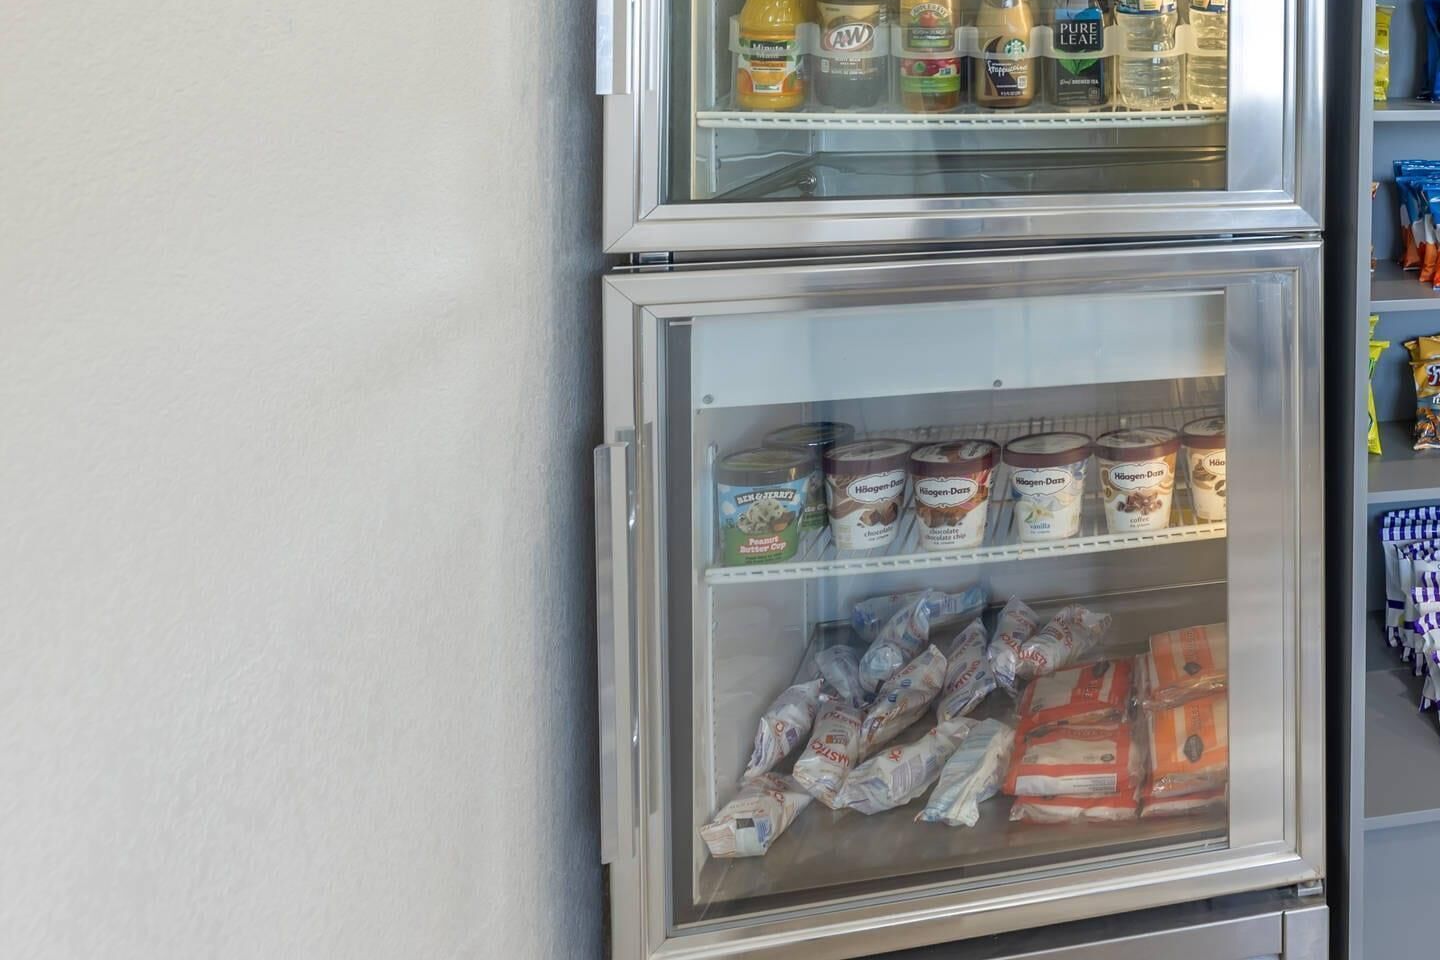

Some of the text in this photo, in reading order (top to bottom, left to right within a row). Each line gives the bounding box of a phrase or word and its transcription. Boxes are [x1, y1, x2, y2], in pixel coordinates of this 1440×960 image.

[1060, 23, 1097, 34] PURE
[832, 25, 868, 48] A&W
[1115, 470, 1165, 480] Häagen-Dazs
